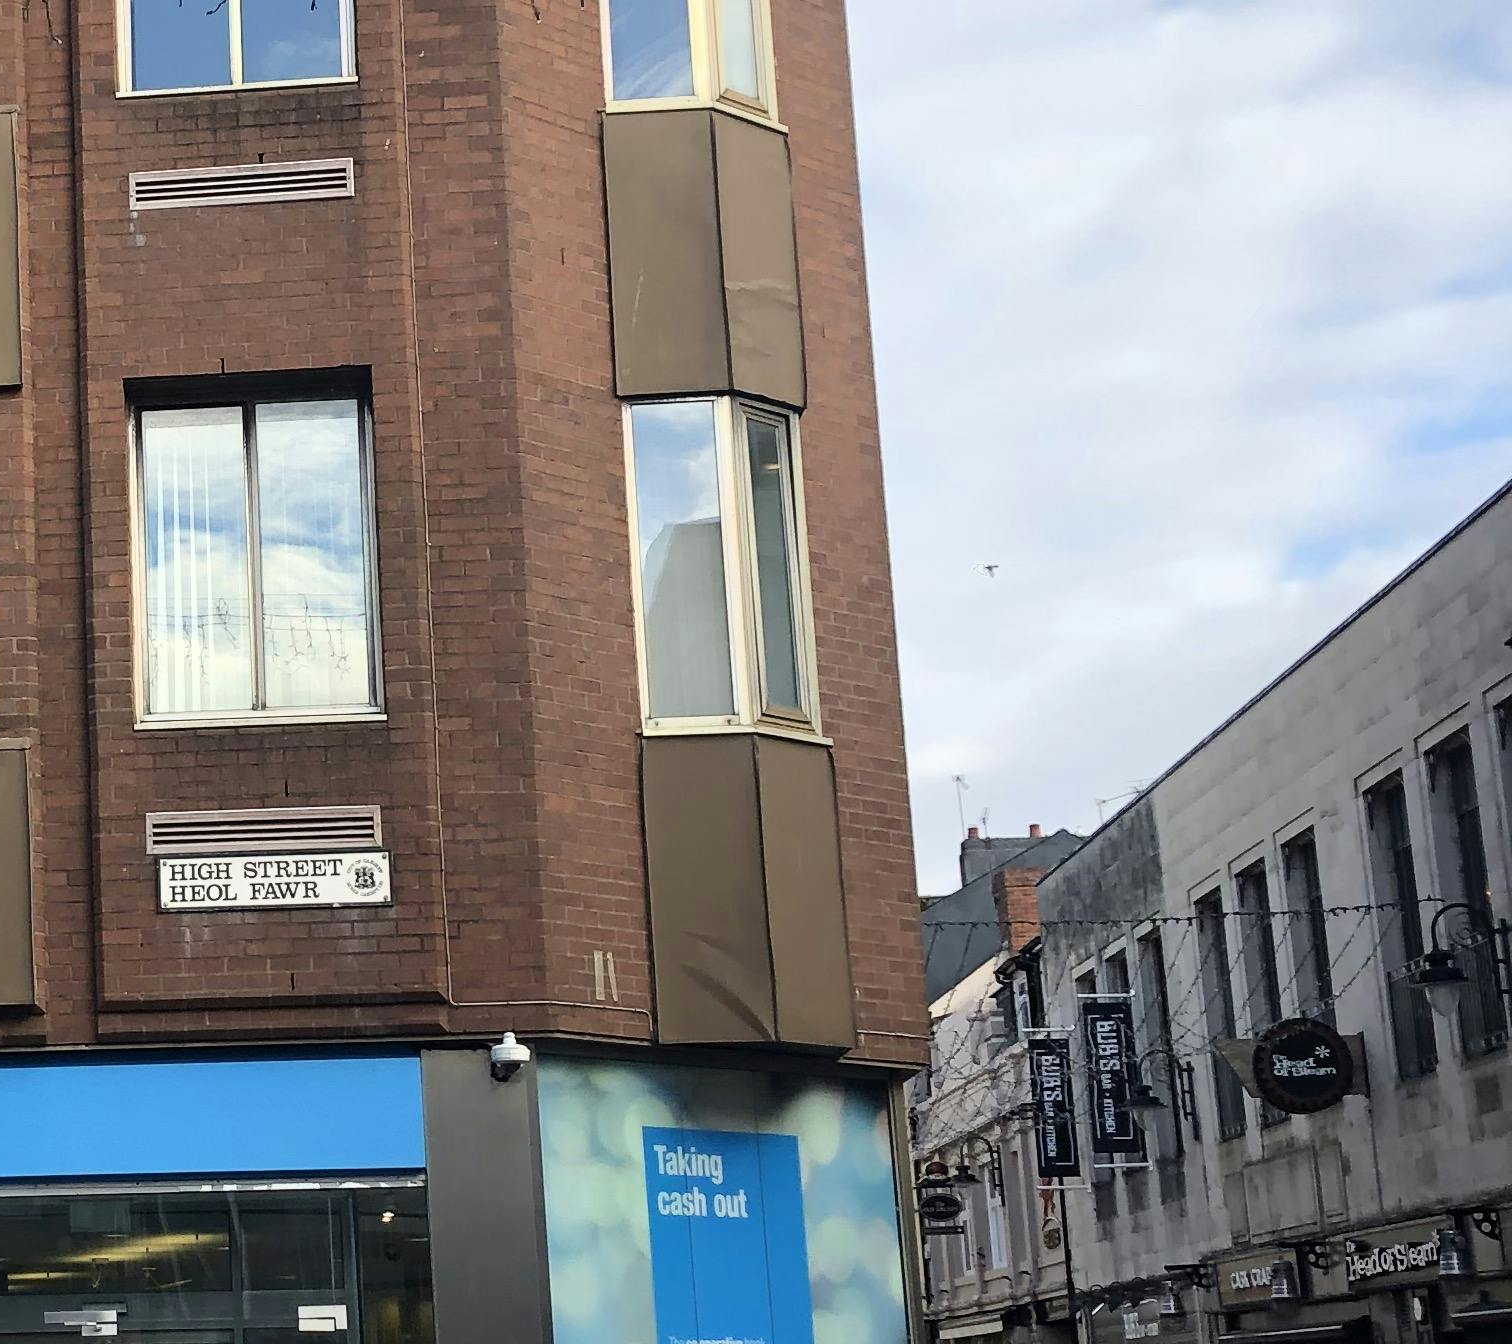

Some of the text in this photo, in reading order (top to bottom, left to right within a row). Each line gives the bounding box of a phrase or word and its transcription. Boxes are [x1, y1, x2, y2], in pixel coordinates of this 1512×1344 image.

[169, 859, 343, 882] HIGH STREET
[169, 881, 320, 903] HEOL FAWR
[1095, 1020, 1121, 1071] BUB'S
[1273, 1058, 1317, 1069] Head
[653, 1144, 724, 1185] Taking
[657, 1187, 749, 1219] cash out
[1345, 1241, 1438, 1281] Head of Steam
